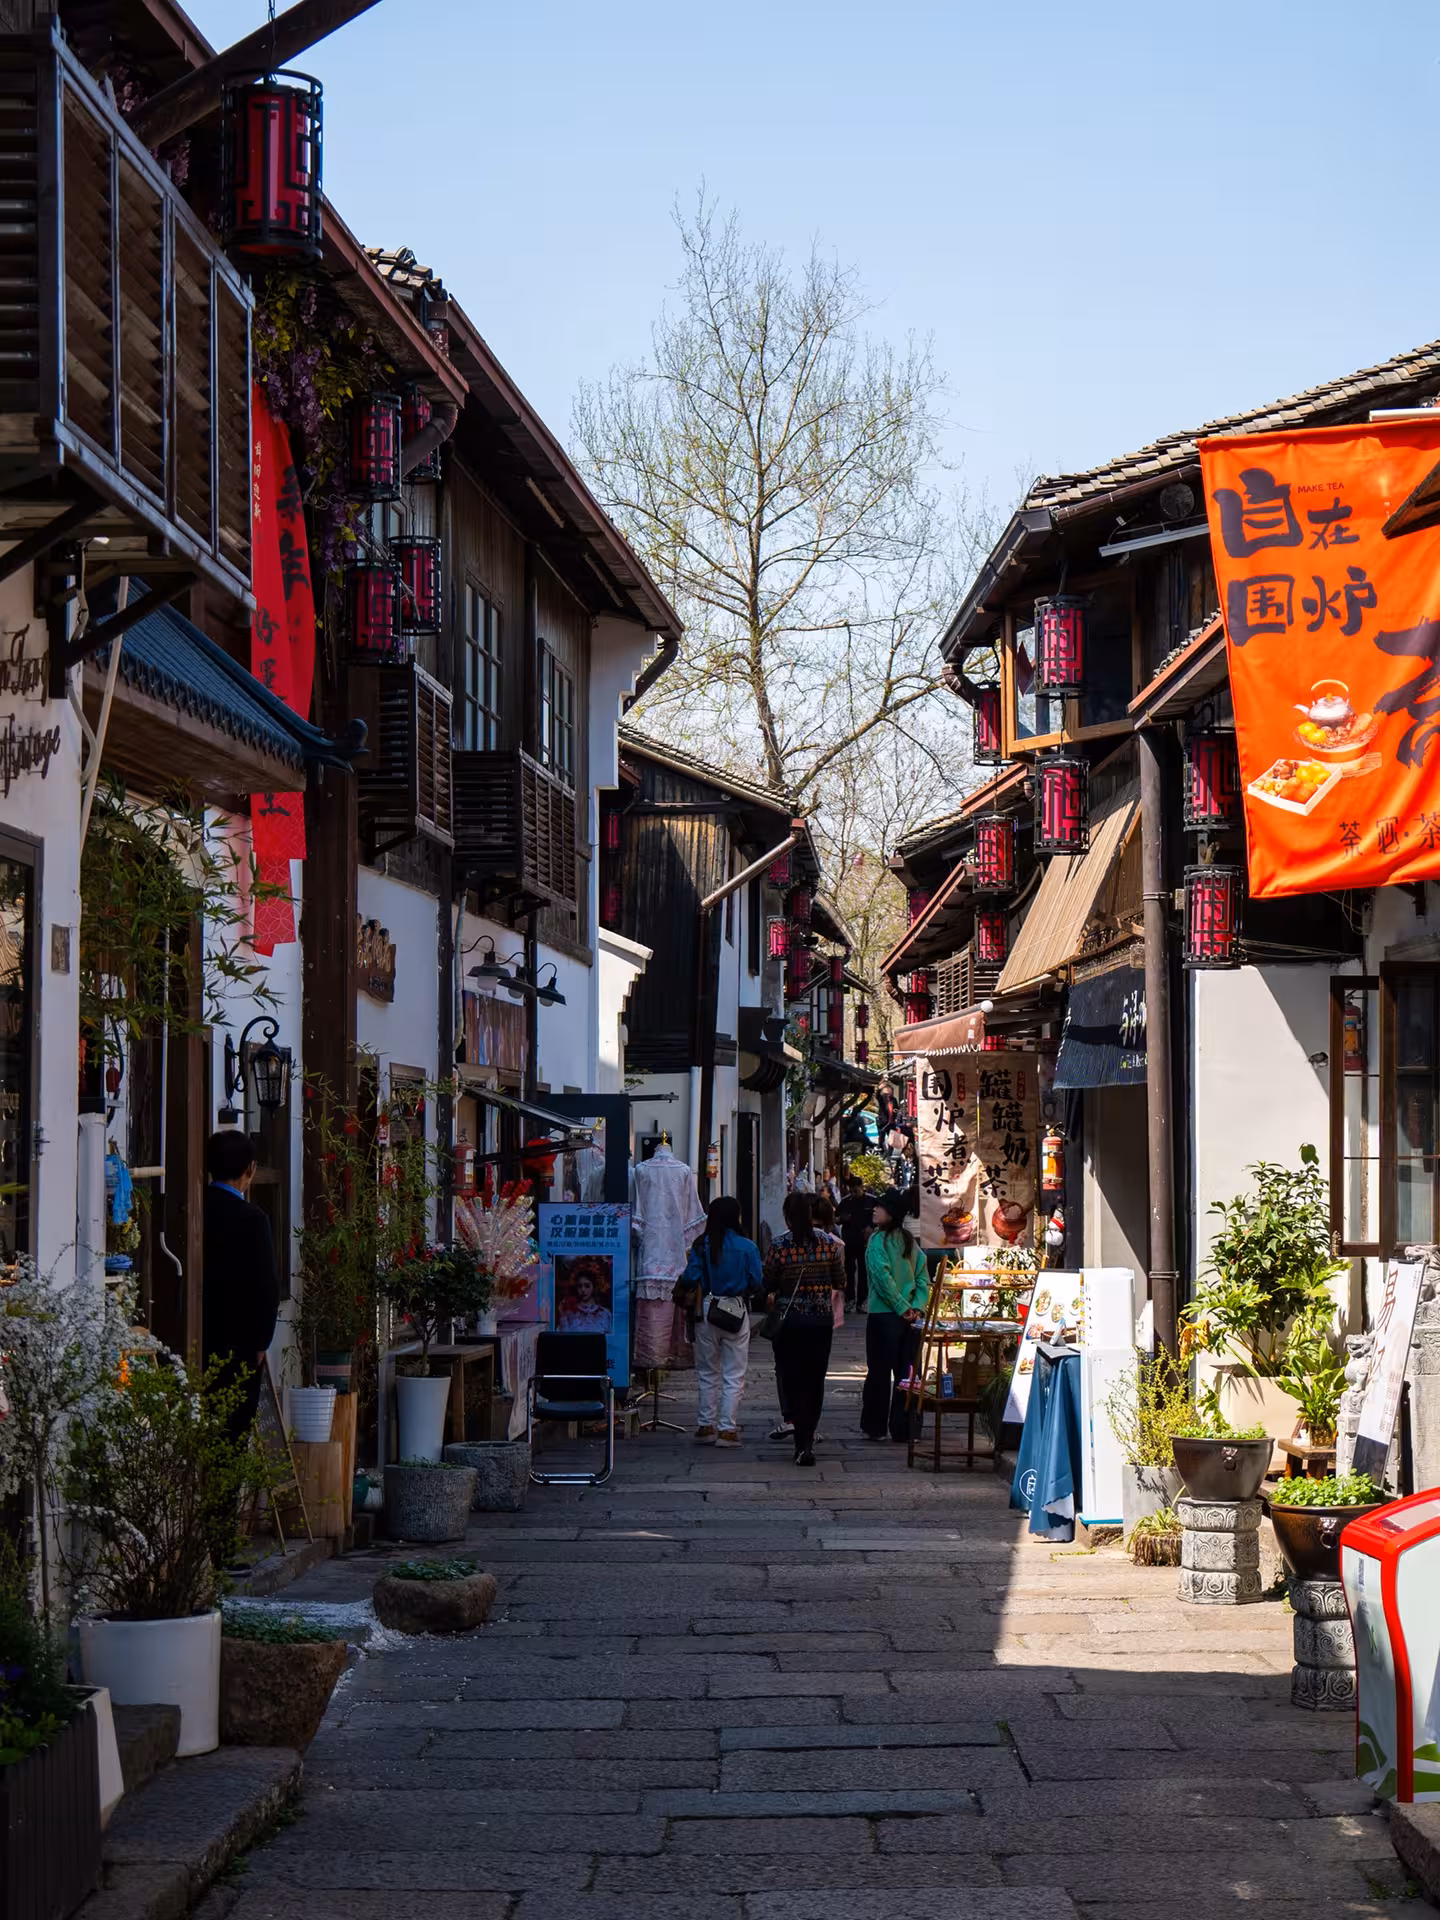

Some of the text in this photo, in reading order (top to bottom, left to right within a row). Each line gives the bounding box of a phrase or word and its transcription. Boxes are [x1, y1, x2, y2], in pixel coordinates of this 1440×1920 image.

[1212, 467, 1360, 559] 自在
[1297, 482, 1345, 494] MAKE TEA
[1227, 565, 1378, 648] 围炉
[921, 1069, 972, 1197] 围炉煮茶
[979, 1068, 1031, 1197] 罐罐奶茶
